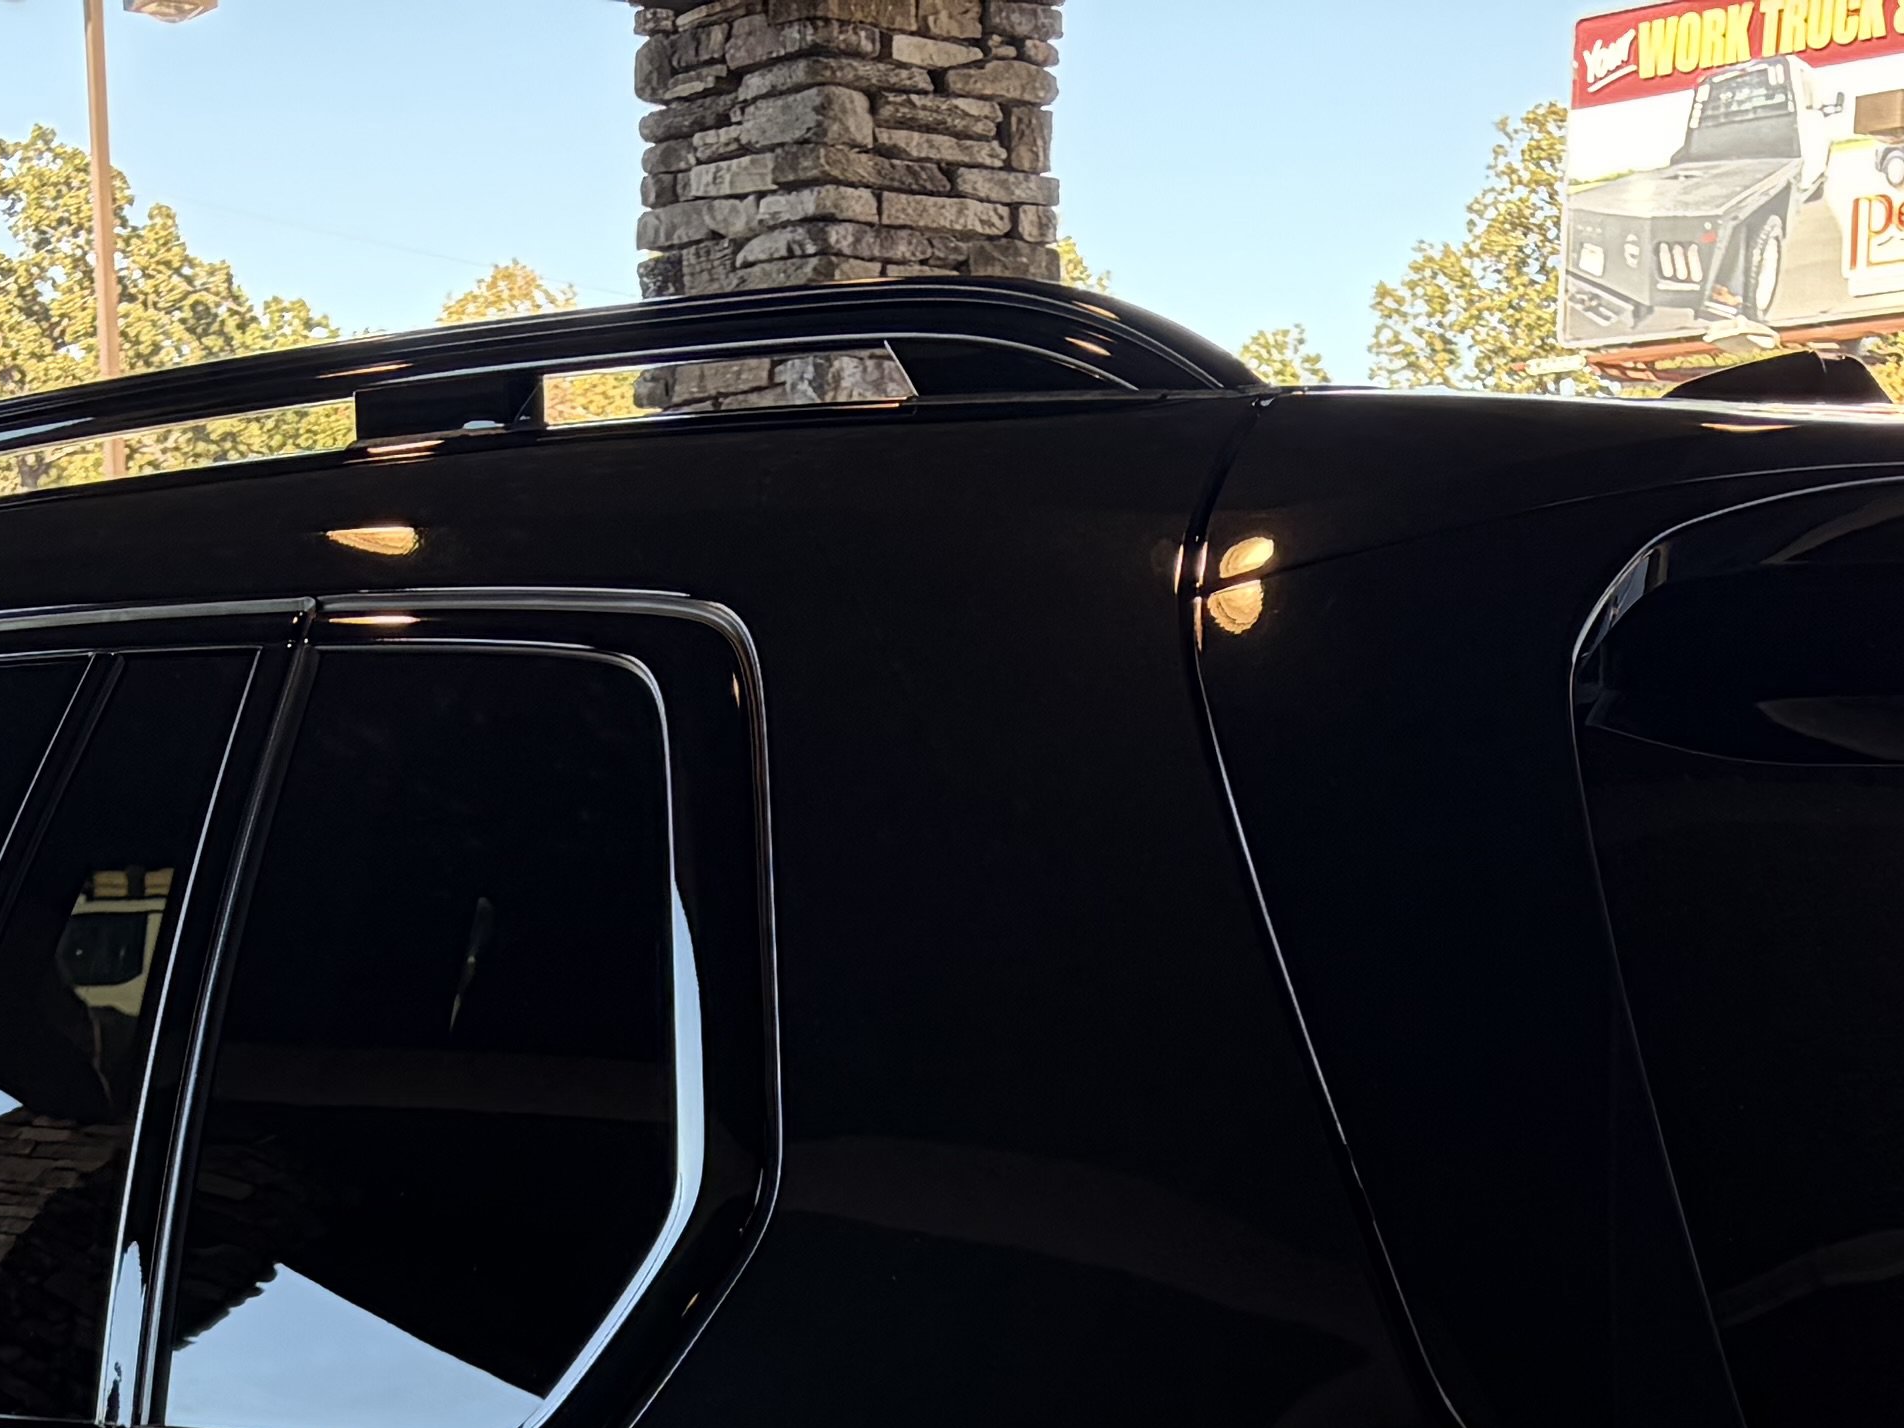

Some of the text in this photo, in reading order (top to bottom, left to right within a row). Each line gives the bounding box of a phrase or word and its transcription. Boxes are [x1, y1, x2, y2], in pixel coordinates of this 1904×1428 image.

[1583, 29, 1637, 83] Your
[1638, 2, 1756, 80] WORK
[1760, 0, 1887, 57] TRUCK
